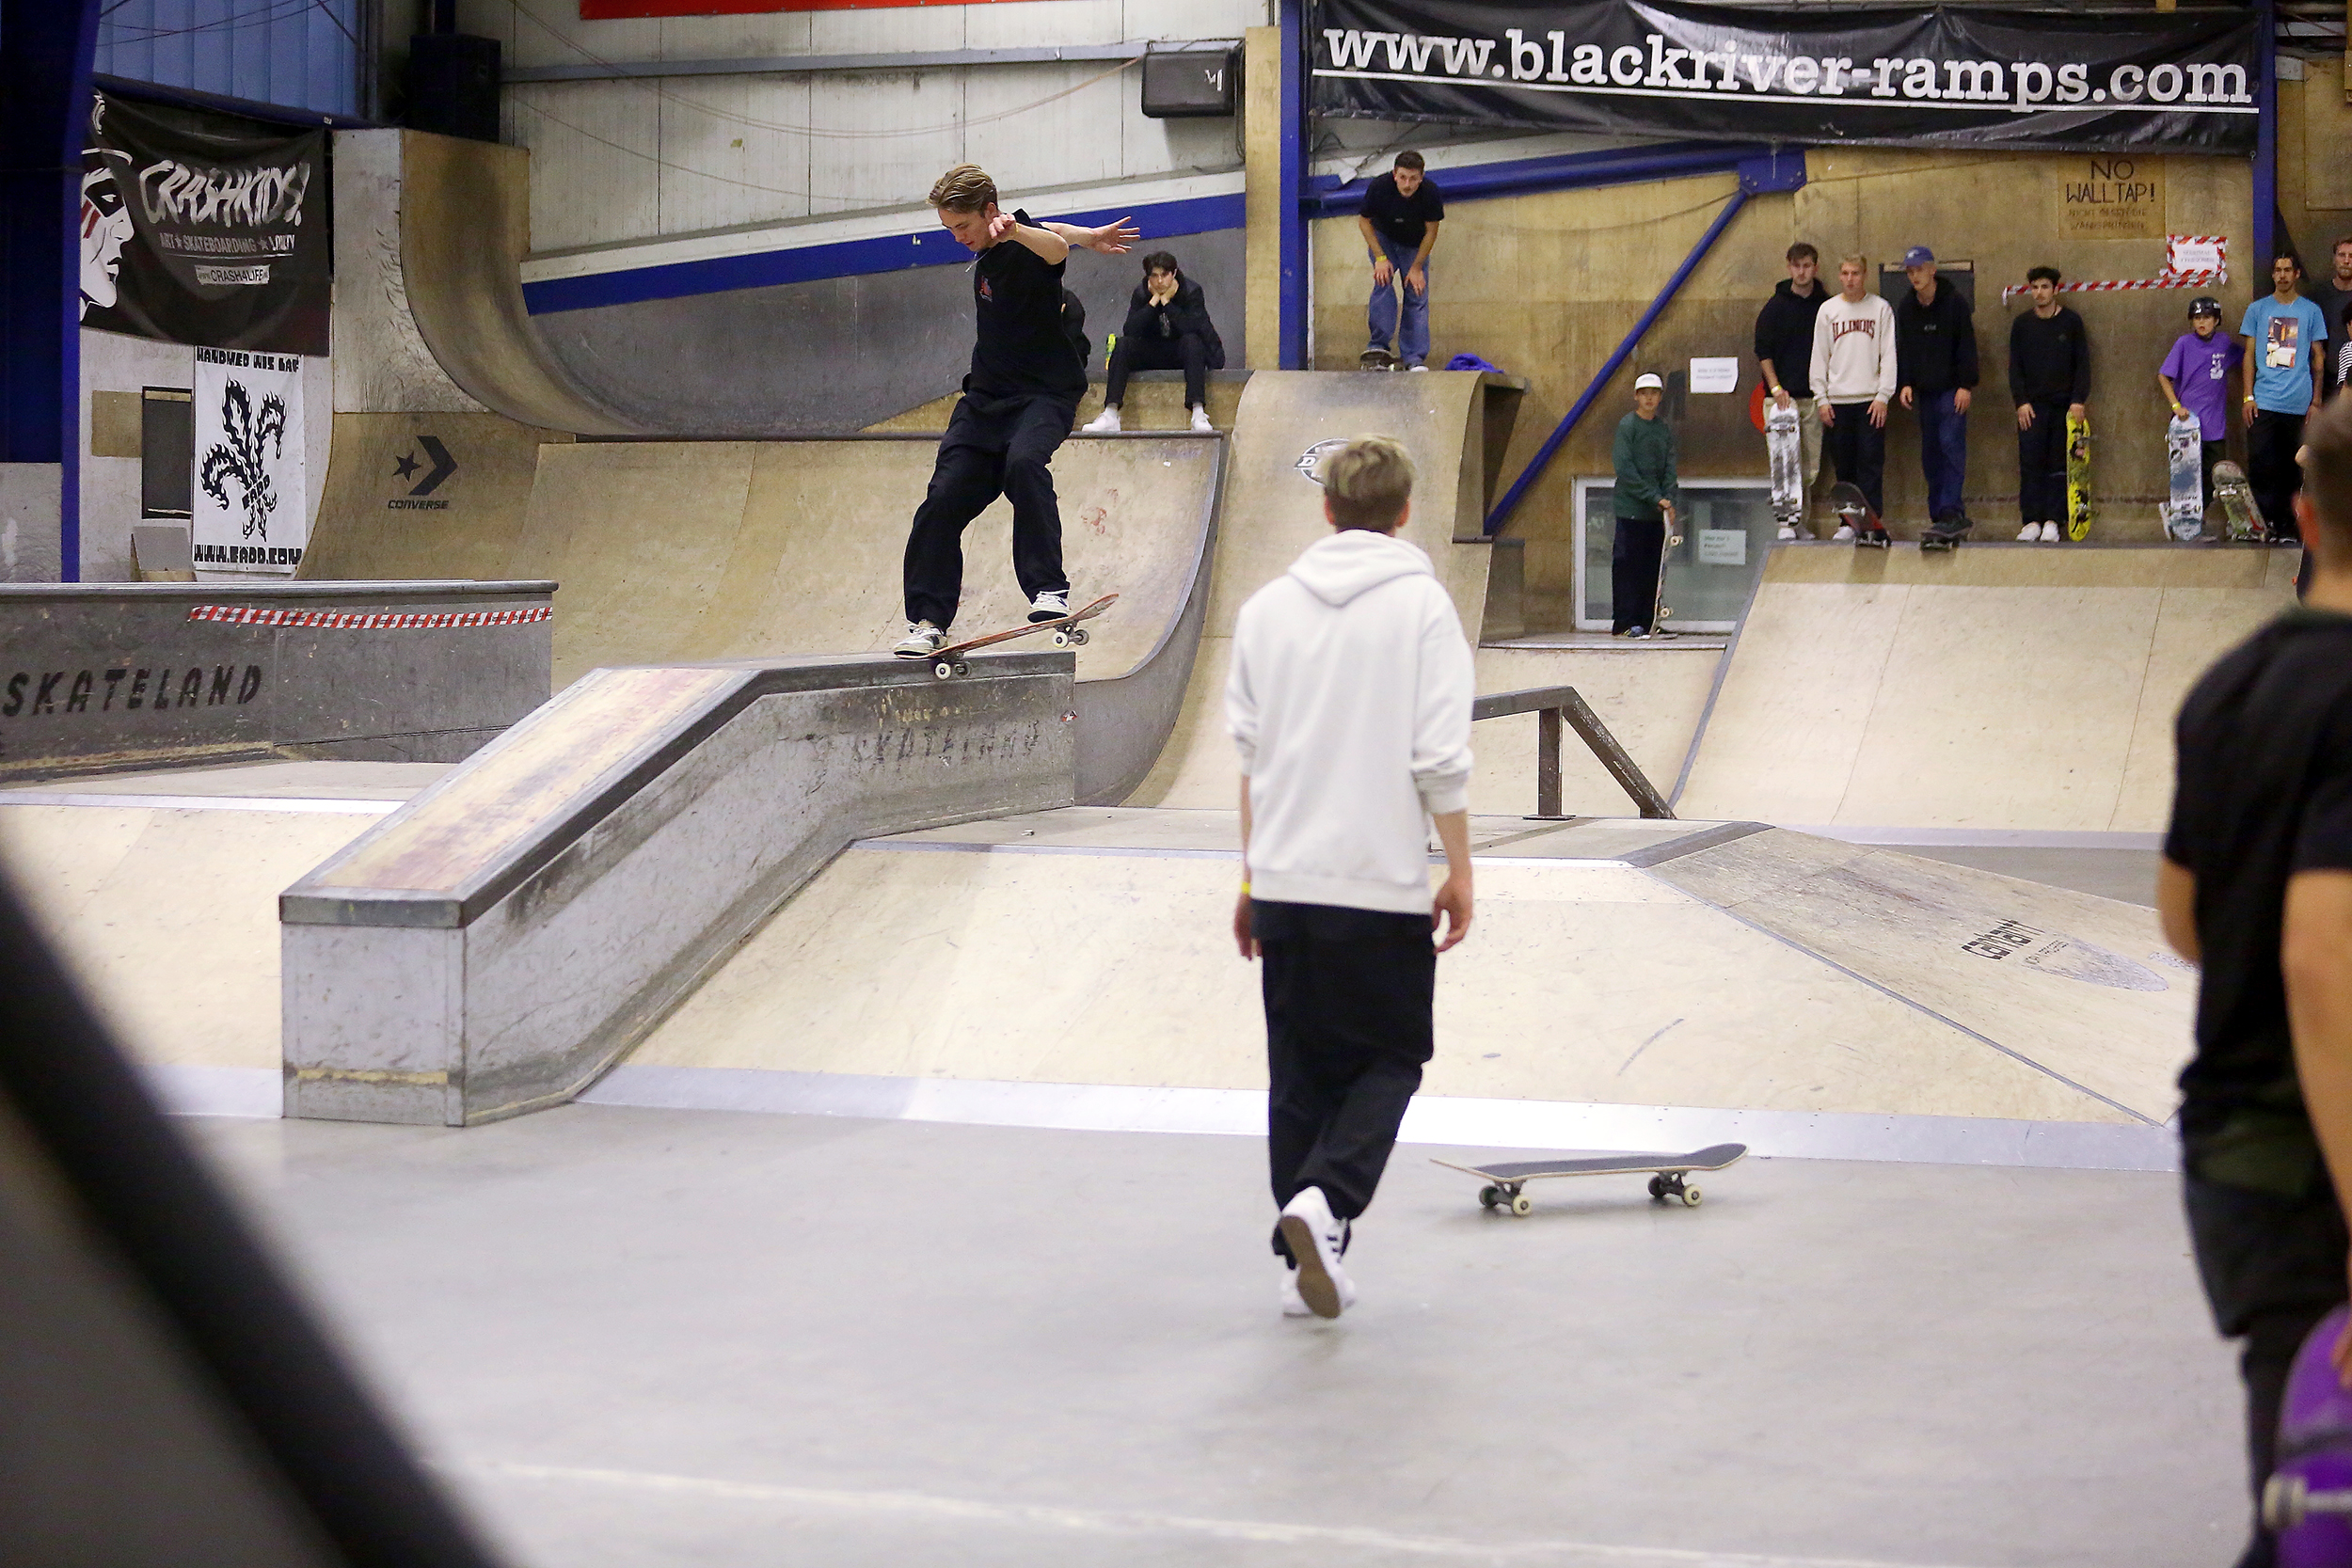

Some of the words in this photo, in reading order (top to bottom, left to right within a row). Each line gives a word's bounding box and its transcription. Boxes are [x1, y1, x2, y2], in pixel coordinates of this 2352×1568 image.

[1323, 28, 2252, 112] www.blackriver-ramps.com
[2090, 159, 2135, 181] NO
[183, 234, 258, 254] SKATEBOARDING
[1831, 319, 1876, 341] ILLINOIS
[388, 499, 450, 510] CONVERSE
[2, 664, 262, 718] SKATELAND
